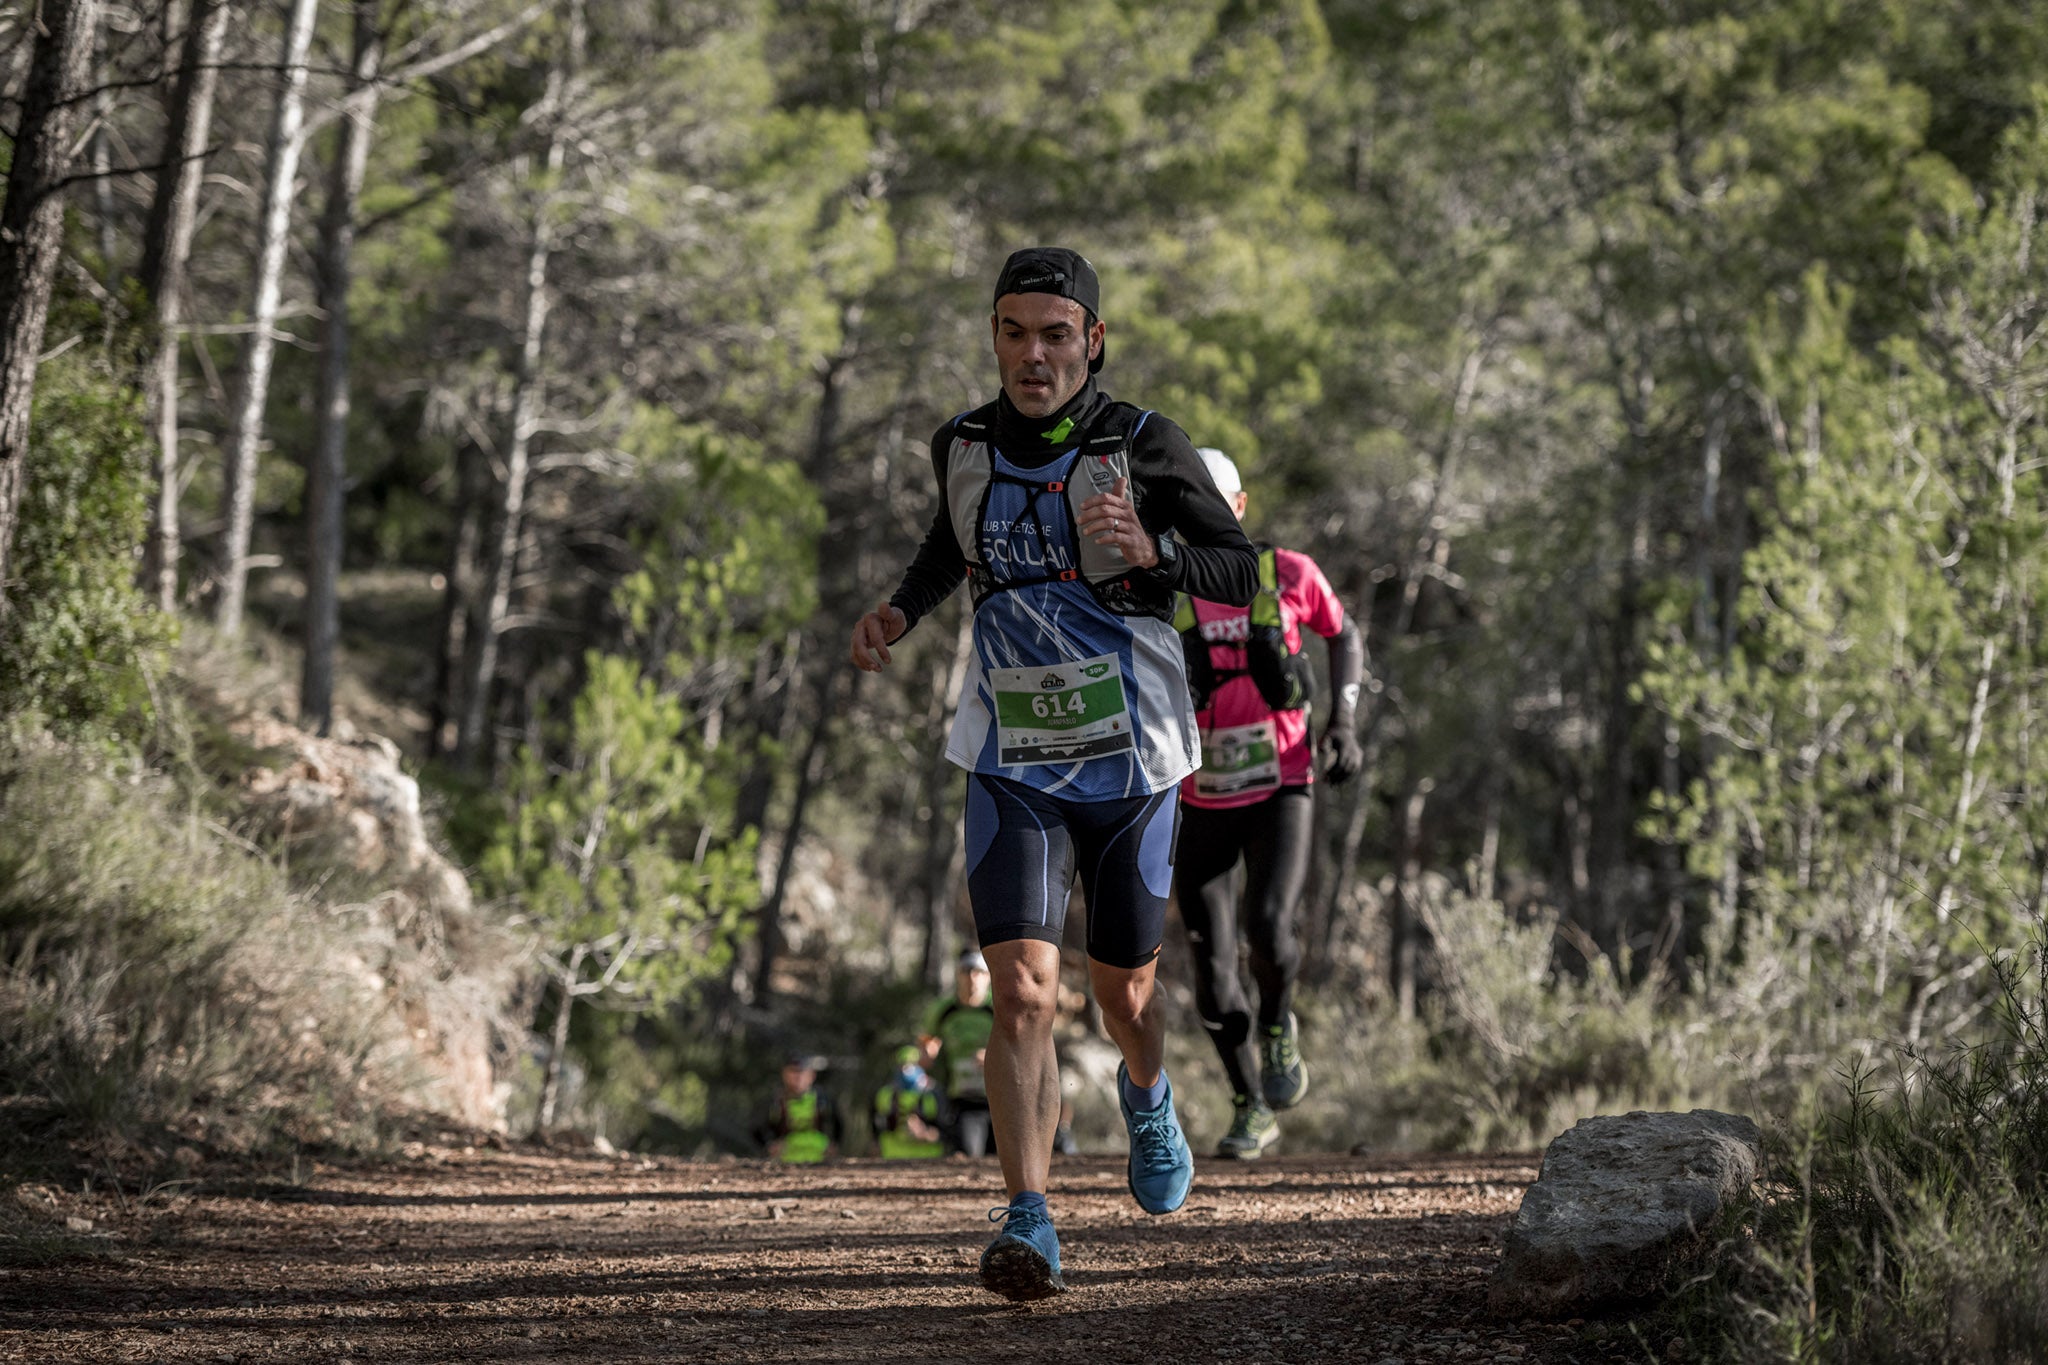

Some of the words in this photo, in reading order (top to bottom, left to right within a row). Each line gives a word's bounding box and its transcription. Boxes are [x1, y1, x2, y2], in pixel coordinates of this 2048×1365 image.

[983, 521, 998, 532] LUB
[1001, 521, 1052, 537] ATETISE
[1031, 691, 1087, 718] 614
